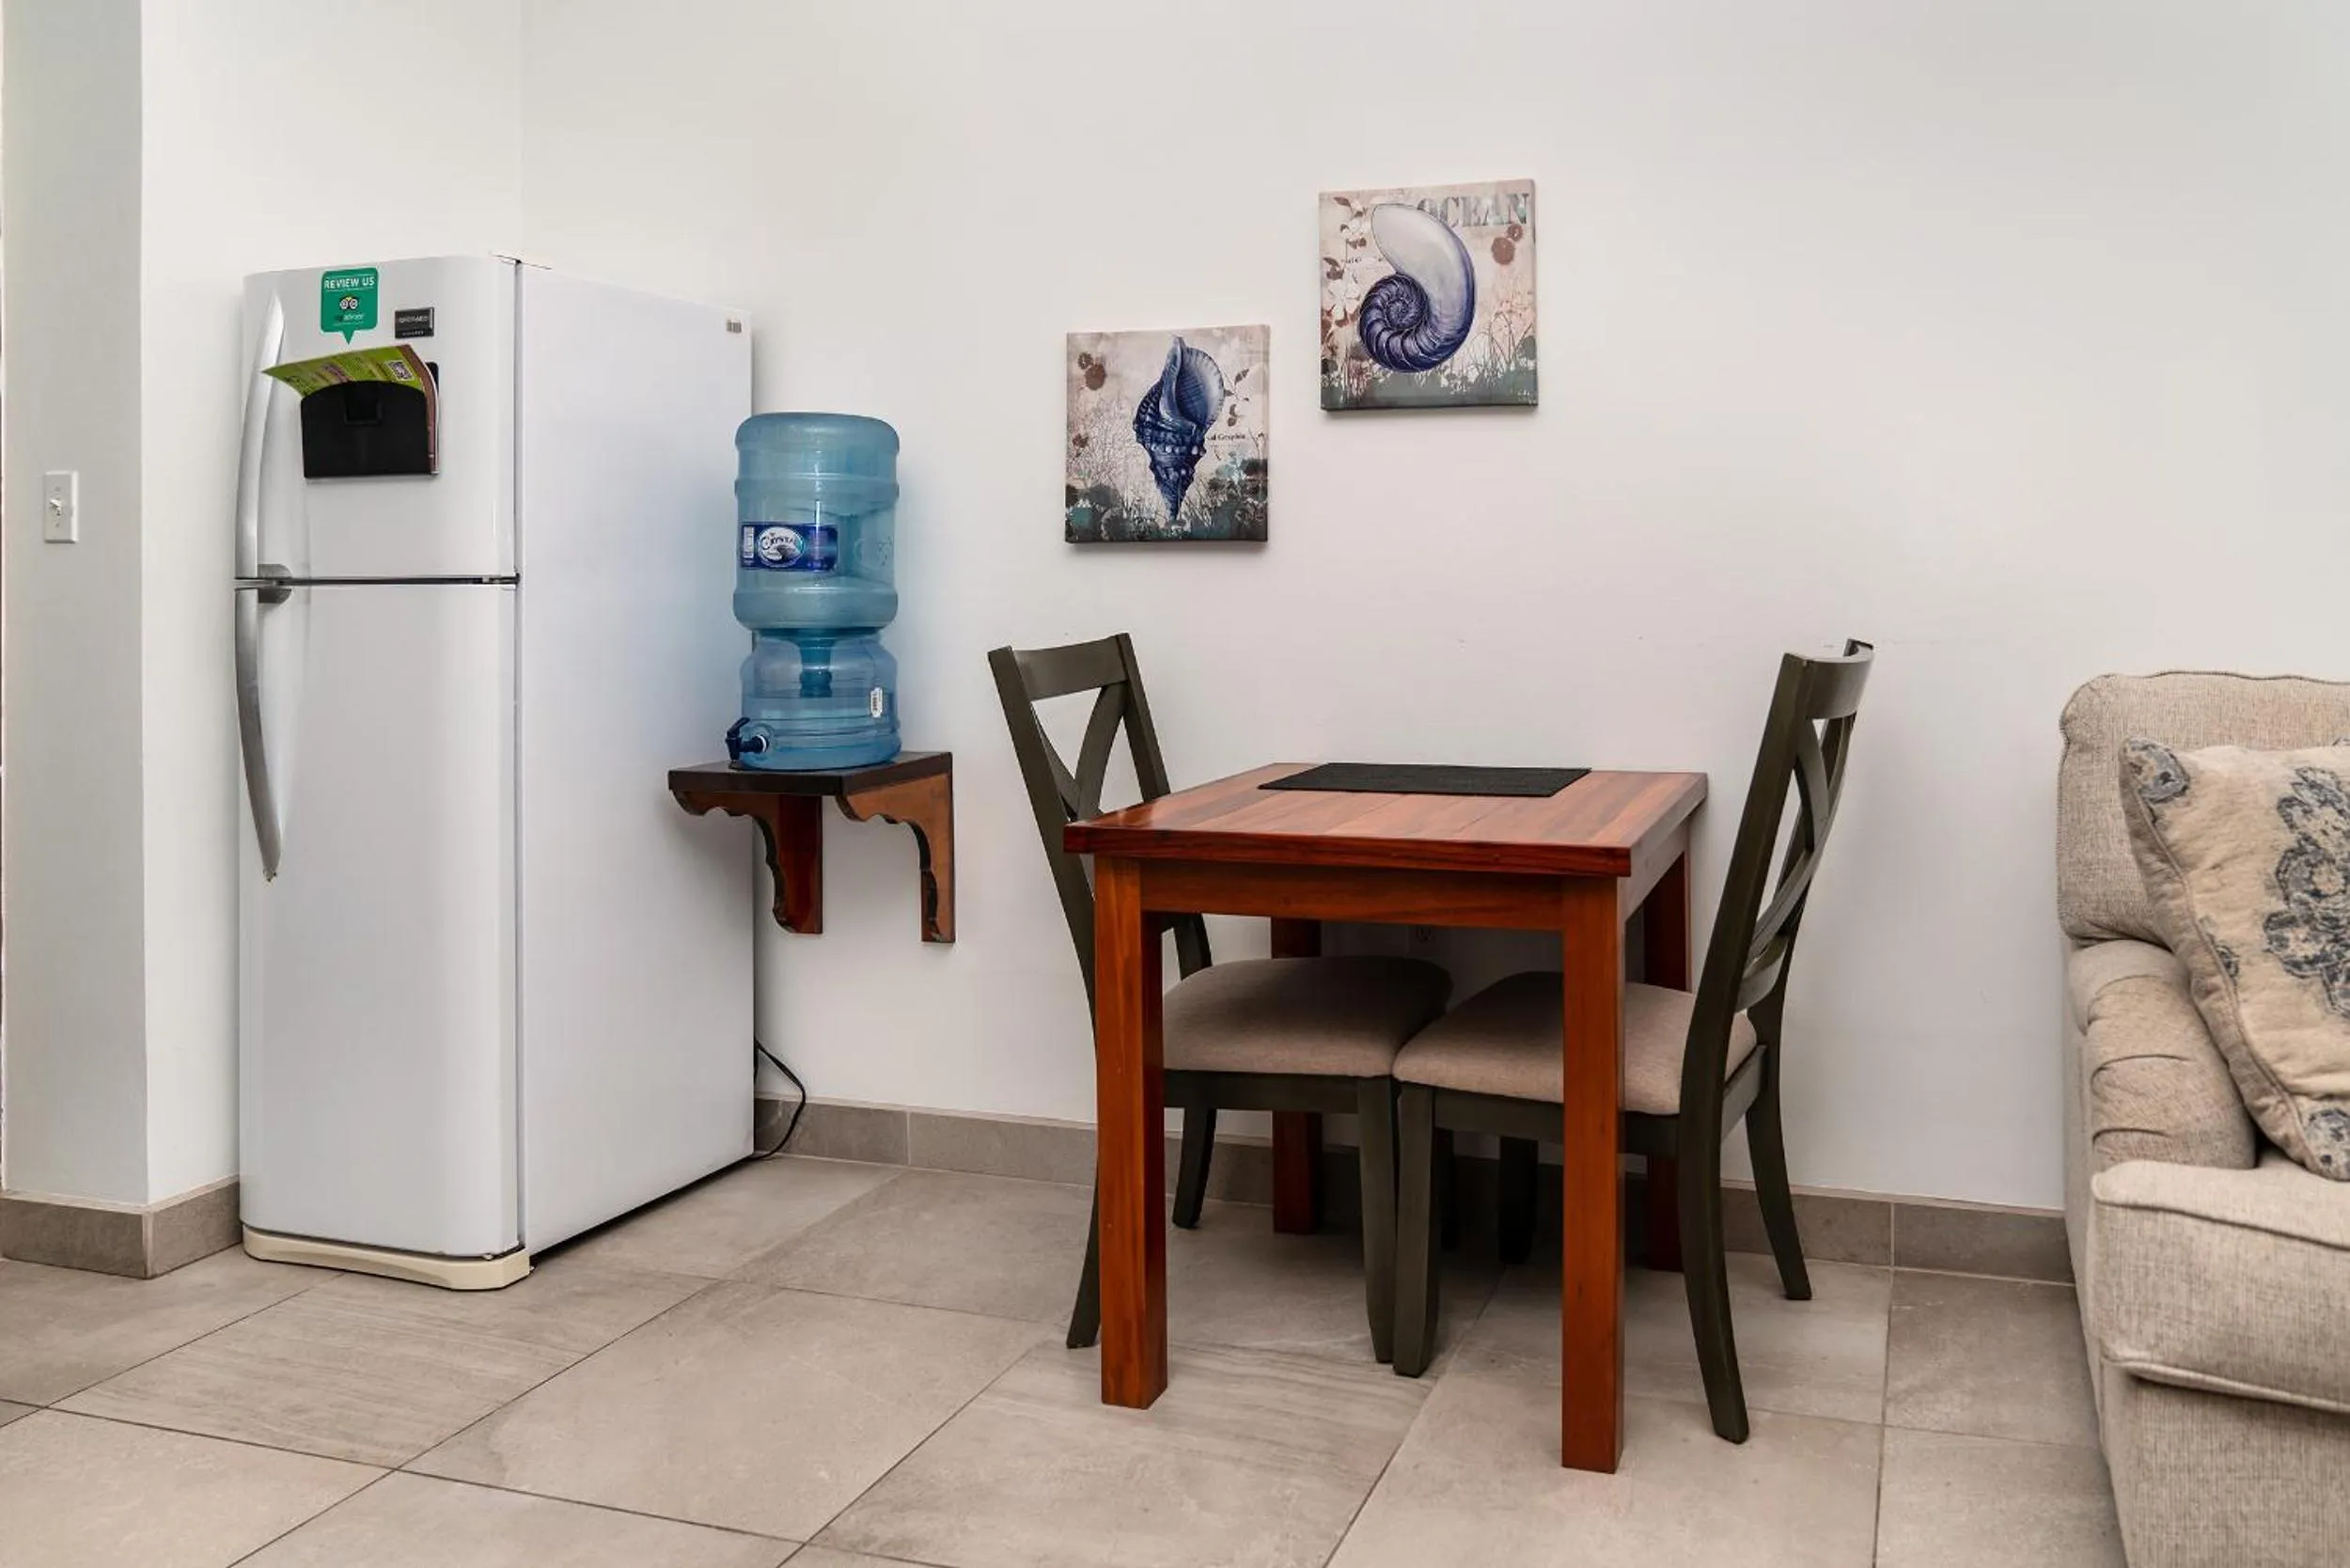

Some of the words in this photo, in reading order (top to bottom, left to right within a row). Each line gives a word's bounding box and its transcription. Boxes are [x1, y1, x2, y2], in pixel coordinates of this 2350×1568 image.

[1417, 193, 1529, 227] OCEAN
[324, 277, 359, 290] REVIEW
[362, 276, 375, 287] US
